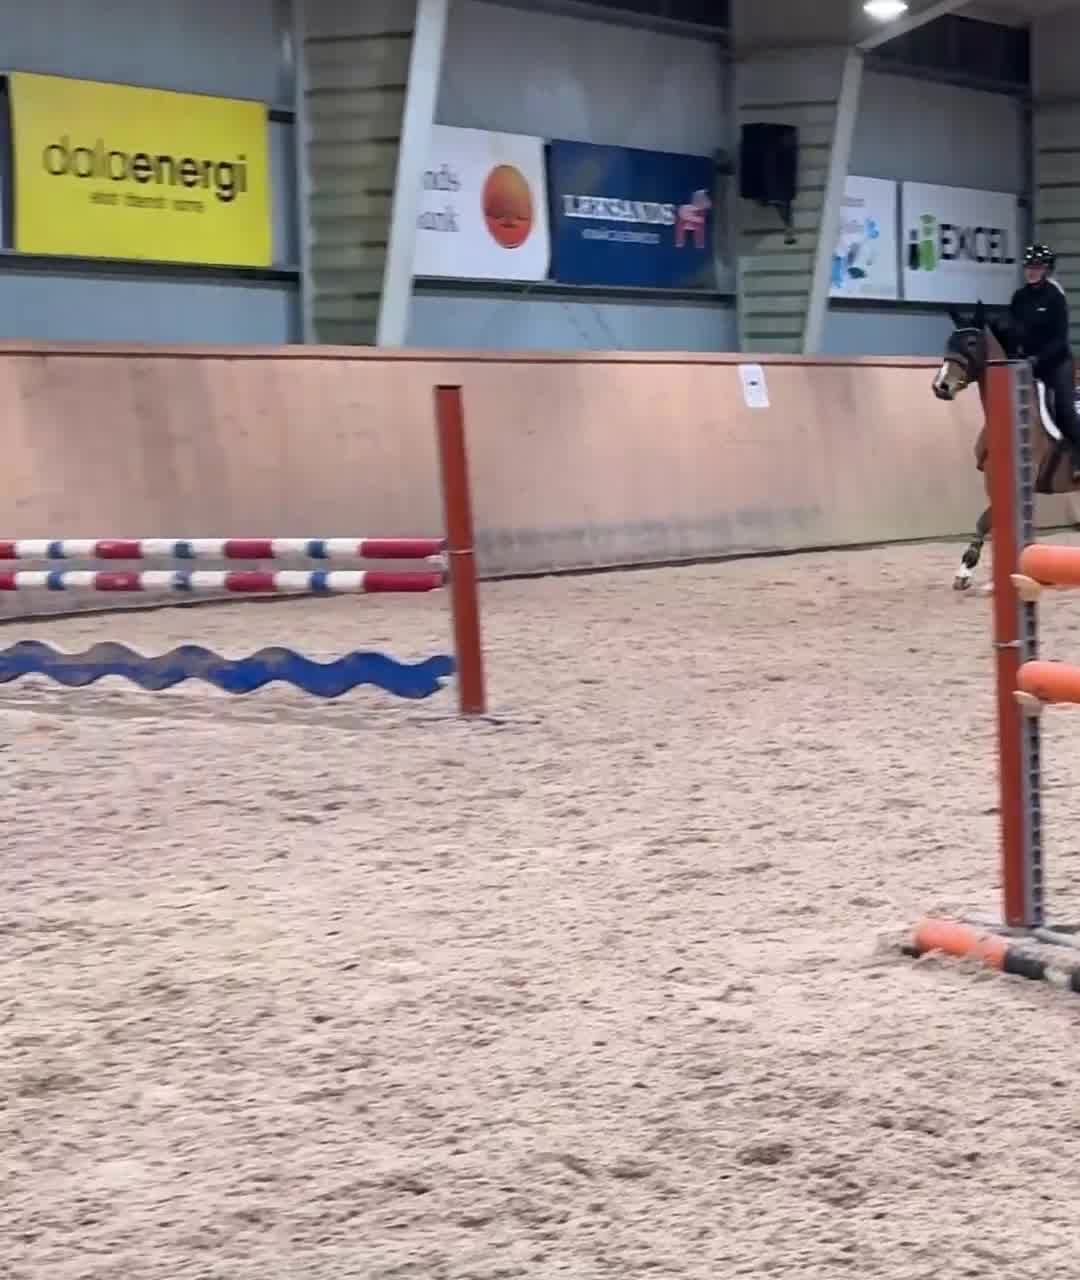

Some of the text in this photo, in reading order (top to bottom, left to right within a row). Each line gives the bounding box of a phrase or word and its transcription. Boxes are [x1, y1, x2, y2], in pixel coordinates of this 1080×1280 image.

[42, 135, 248, 203] dalaenergi
[561, 194, 676, 226] LEKSANDS
[938, 222, 1016, 265] EXCEL
